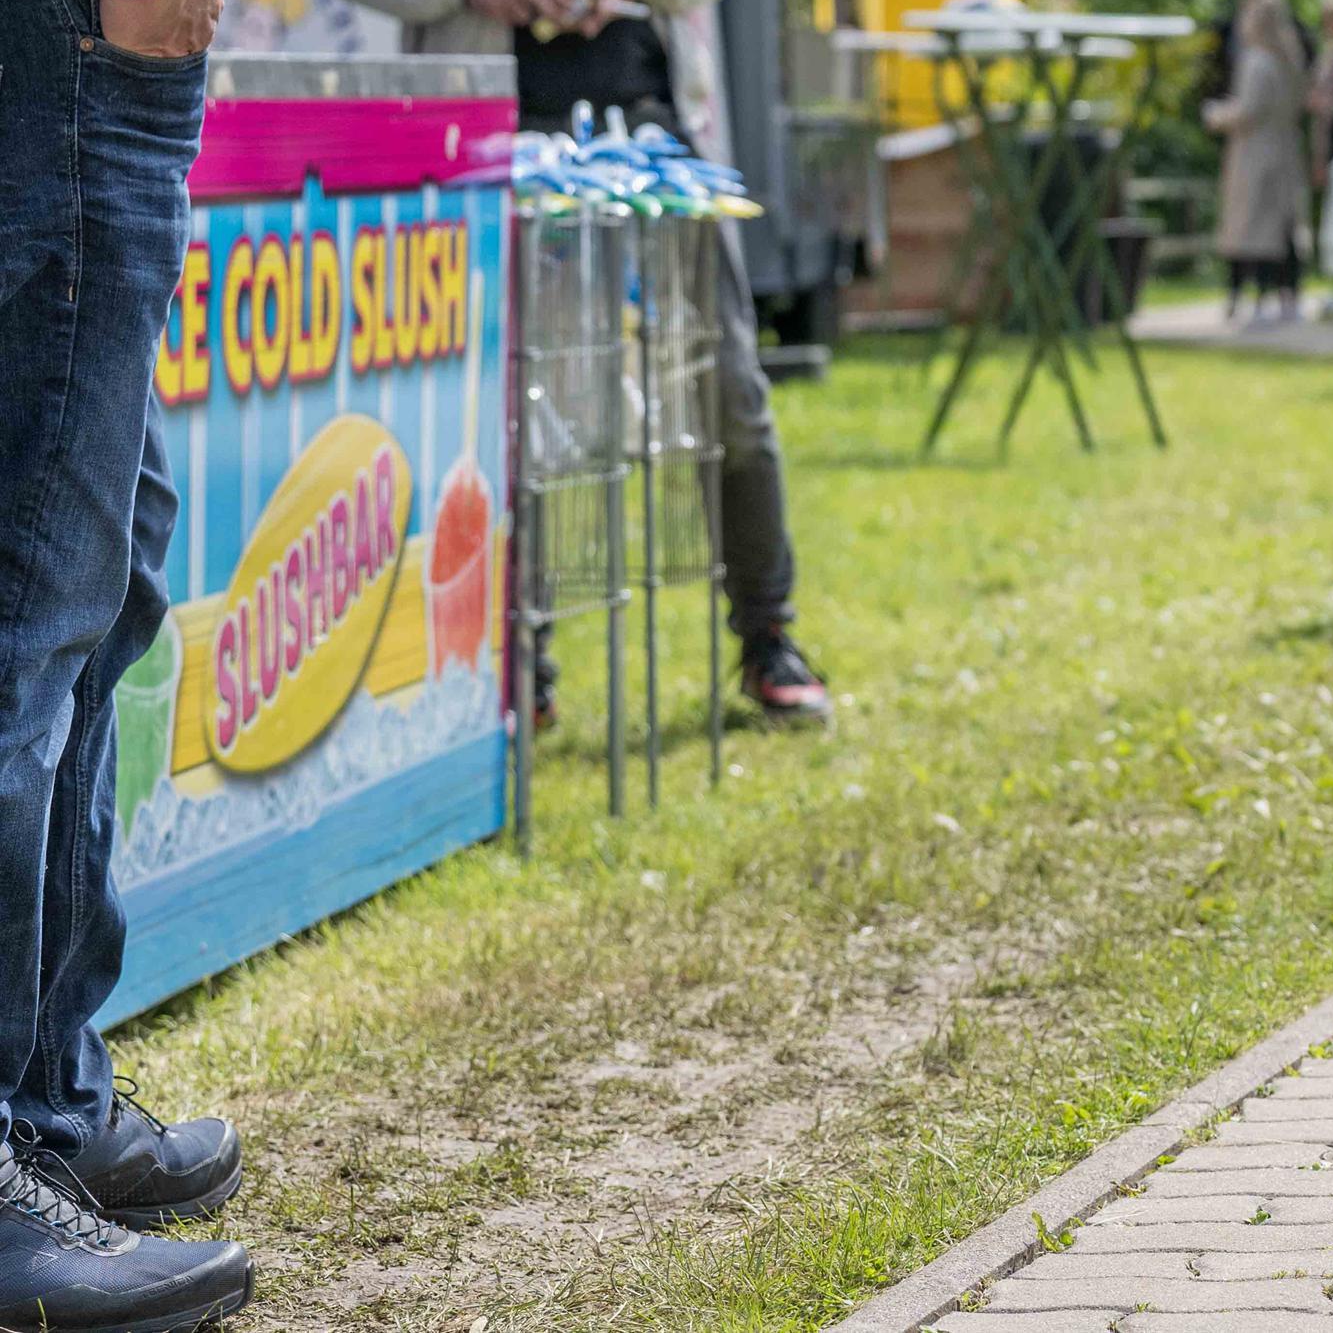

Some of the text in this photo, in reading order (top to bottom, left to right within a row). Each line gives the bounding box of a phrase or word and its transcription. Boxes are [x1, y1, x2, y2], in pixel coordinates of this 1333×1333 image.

[222, 232, 341, 393] COLD
[351, 220, 467, 373] SLUSH
[215, 446, 396, 752] SLUSHBAR
